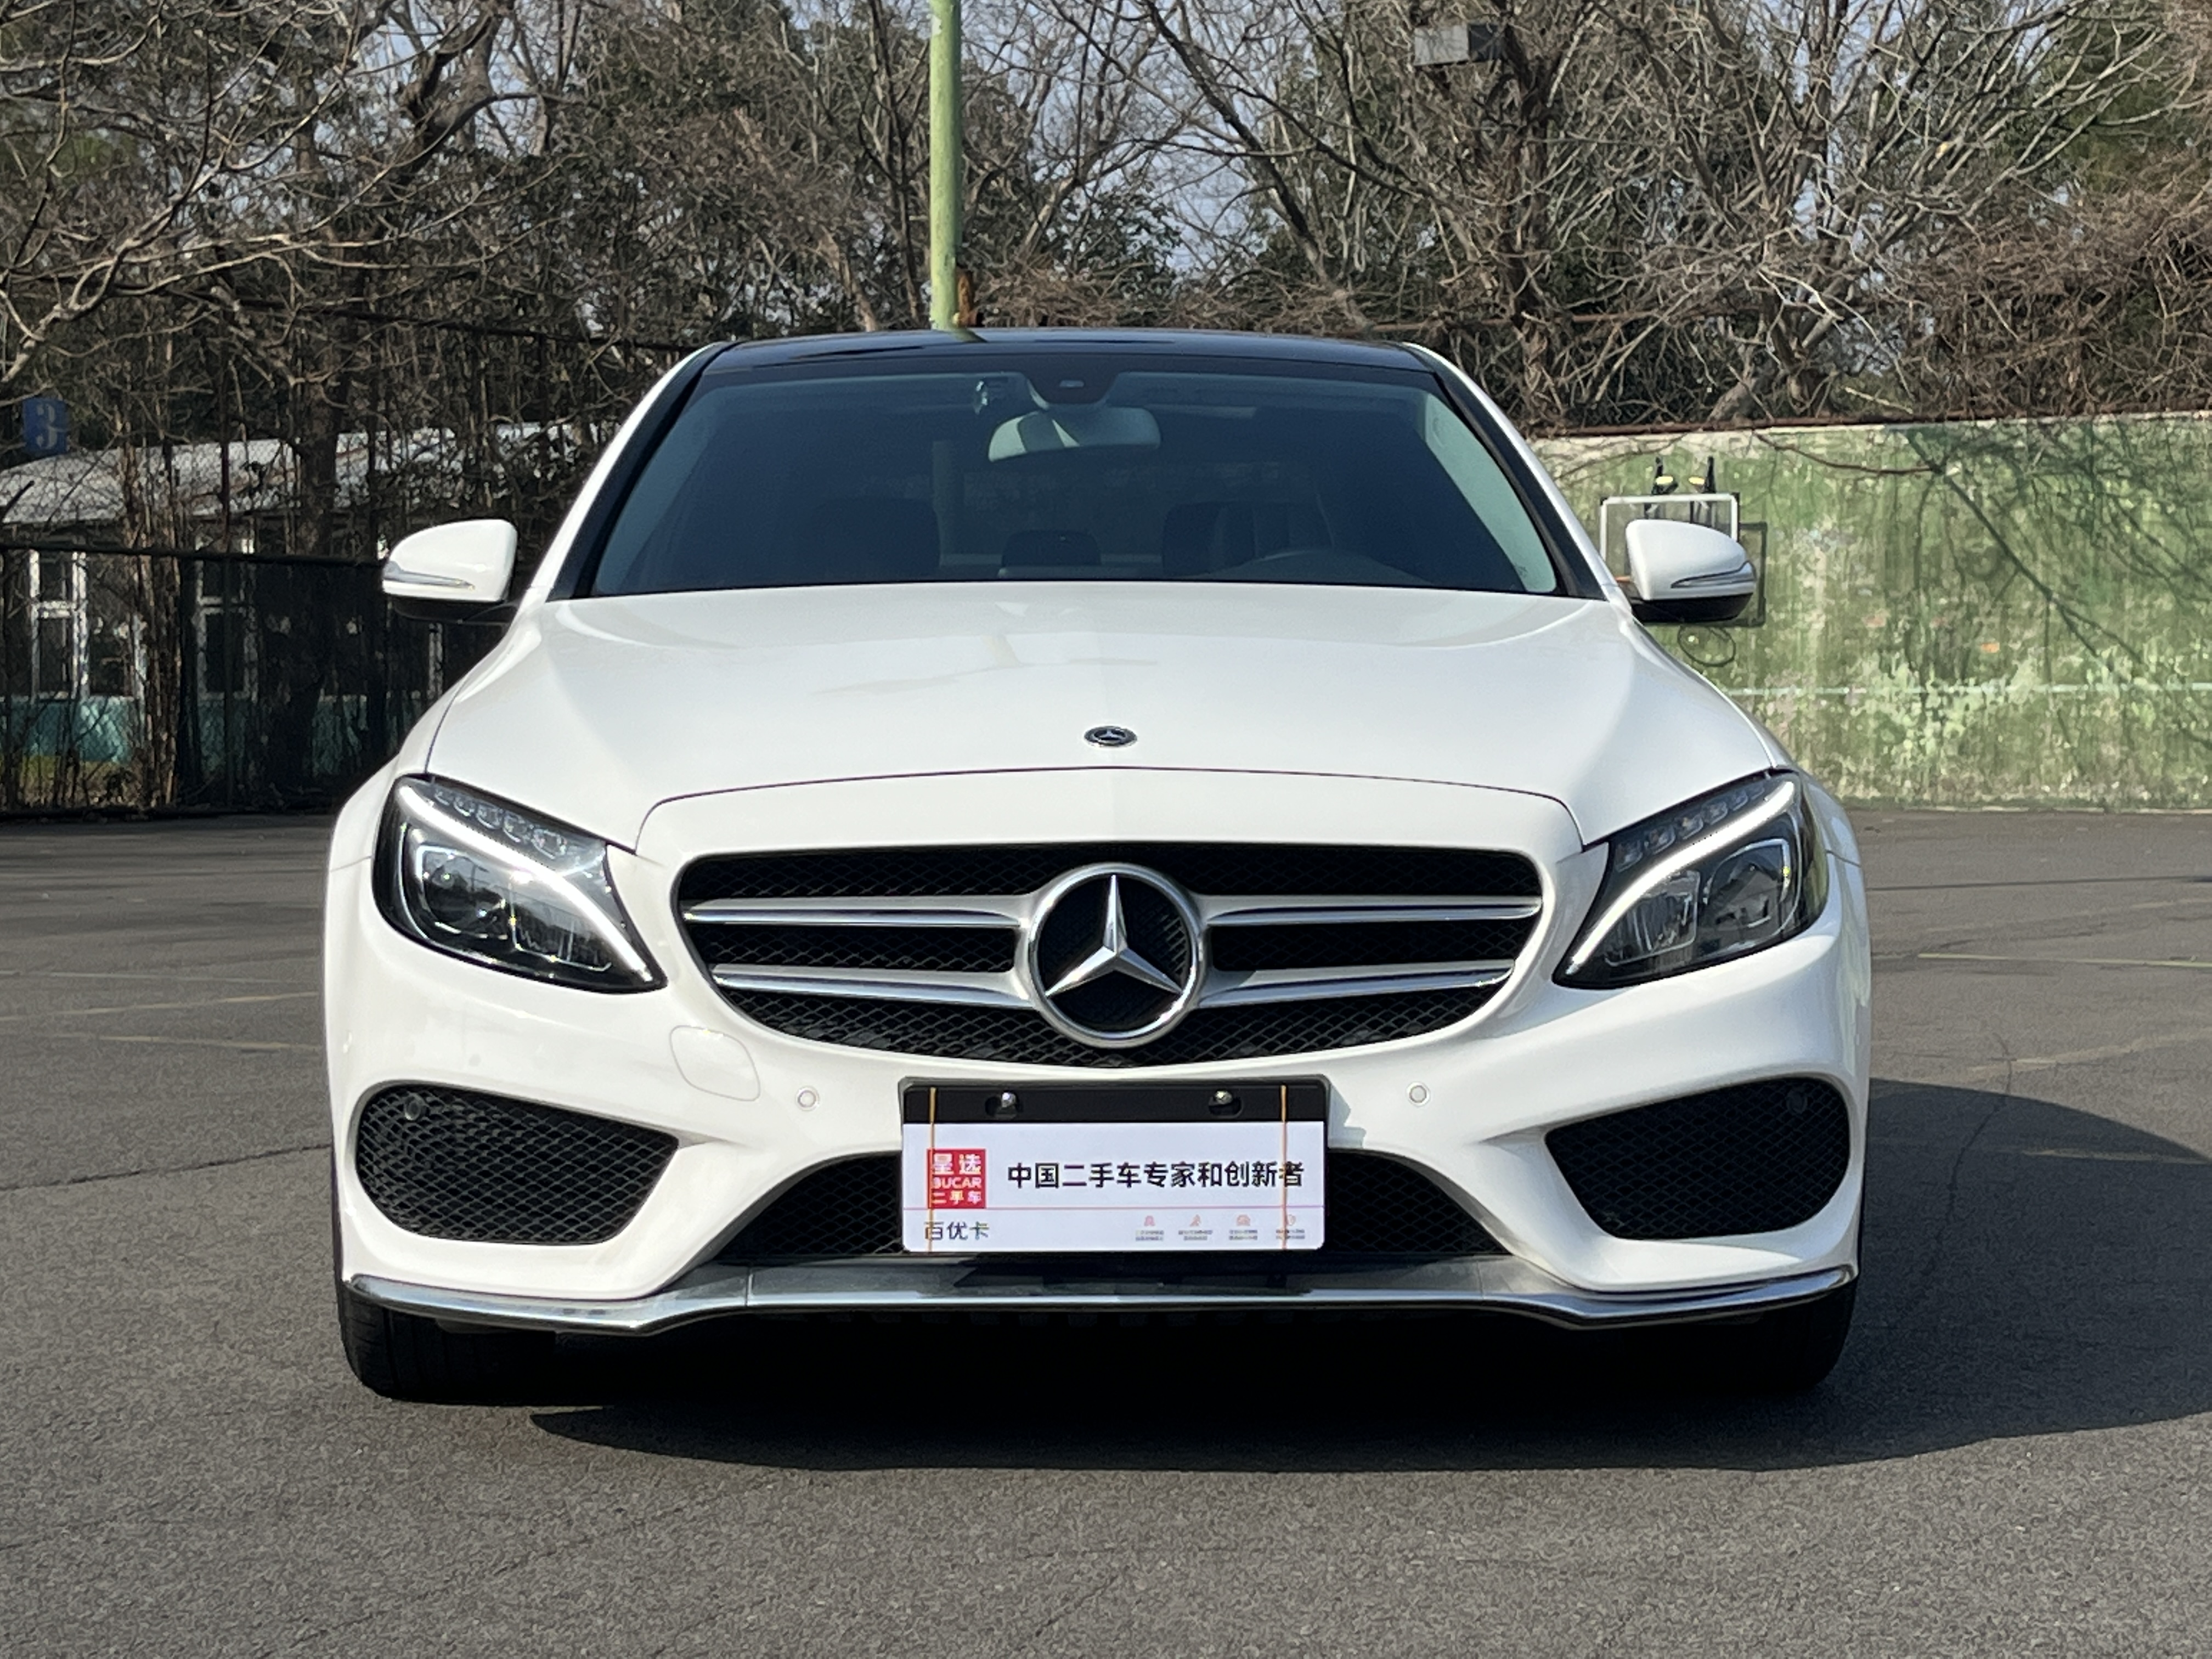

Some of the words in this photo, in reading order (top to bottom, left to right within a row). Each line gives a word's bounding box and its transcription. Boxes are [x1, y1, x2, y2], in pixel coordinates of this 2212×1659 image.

[1007, 1161, 1304, 1189] 中国二手车专家和创新者
[924, 1221, 990, 1240] 百优卡
